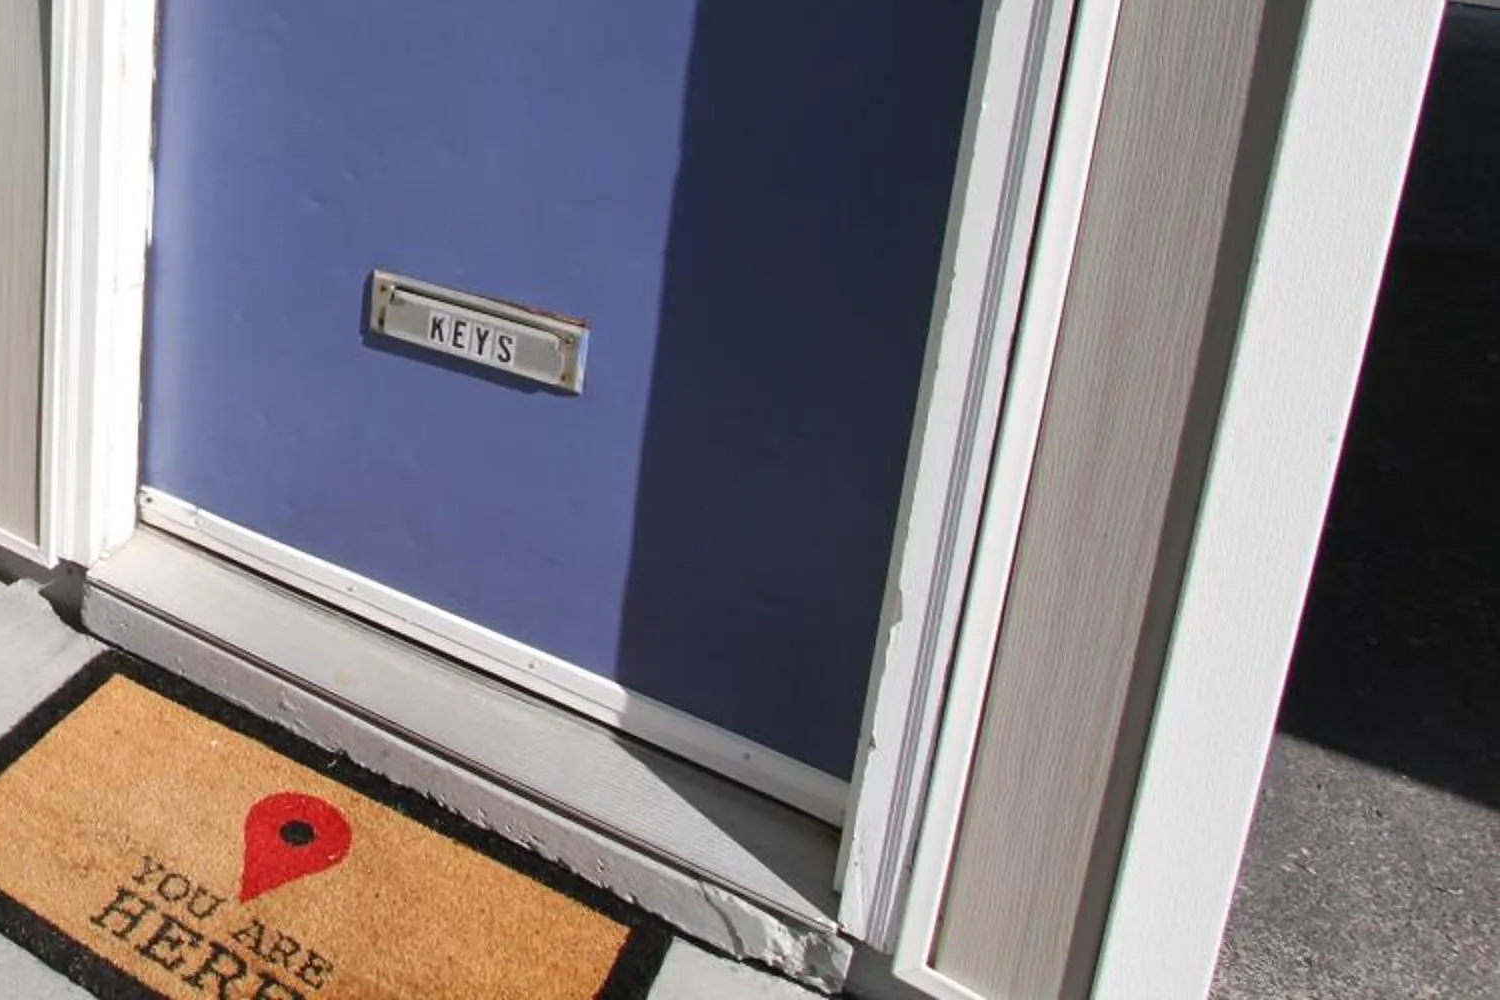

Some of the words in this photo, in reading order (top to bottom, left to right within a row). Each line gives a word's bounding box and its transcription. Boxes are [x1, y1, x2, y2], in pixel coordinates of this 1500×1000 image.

[430, 315, 515, 363] KEYS
[132, 855, 229, 920] YOU
[230, 918, 335, 990] ARE
